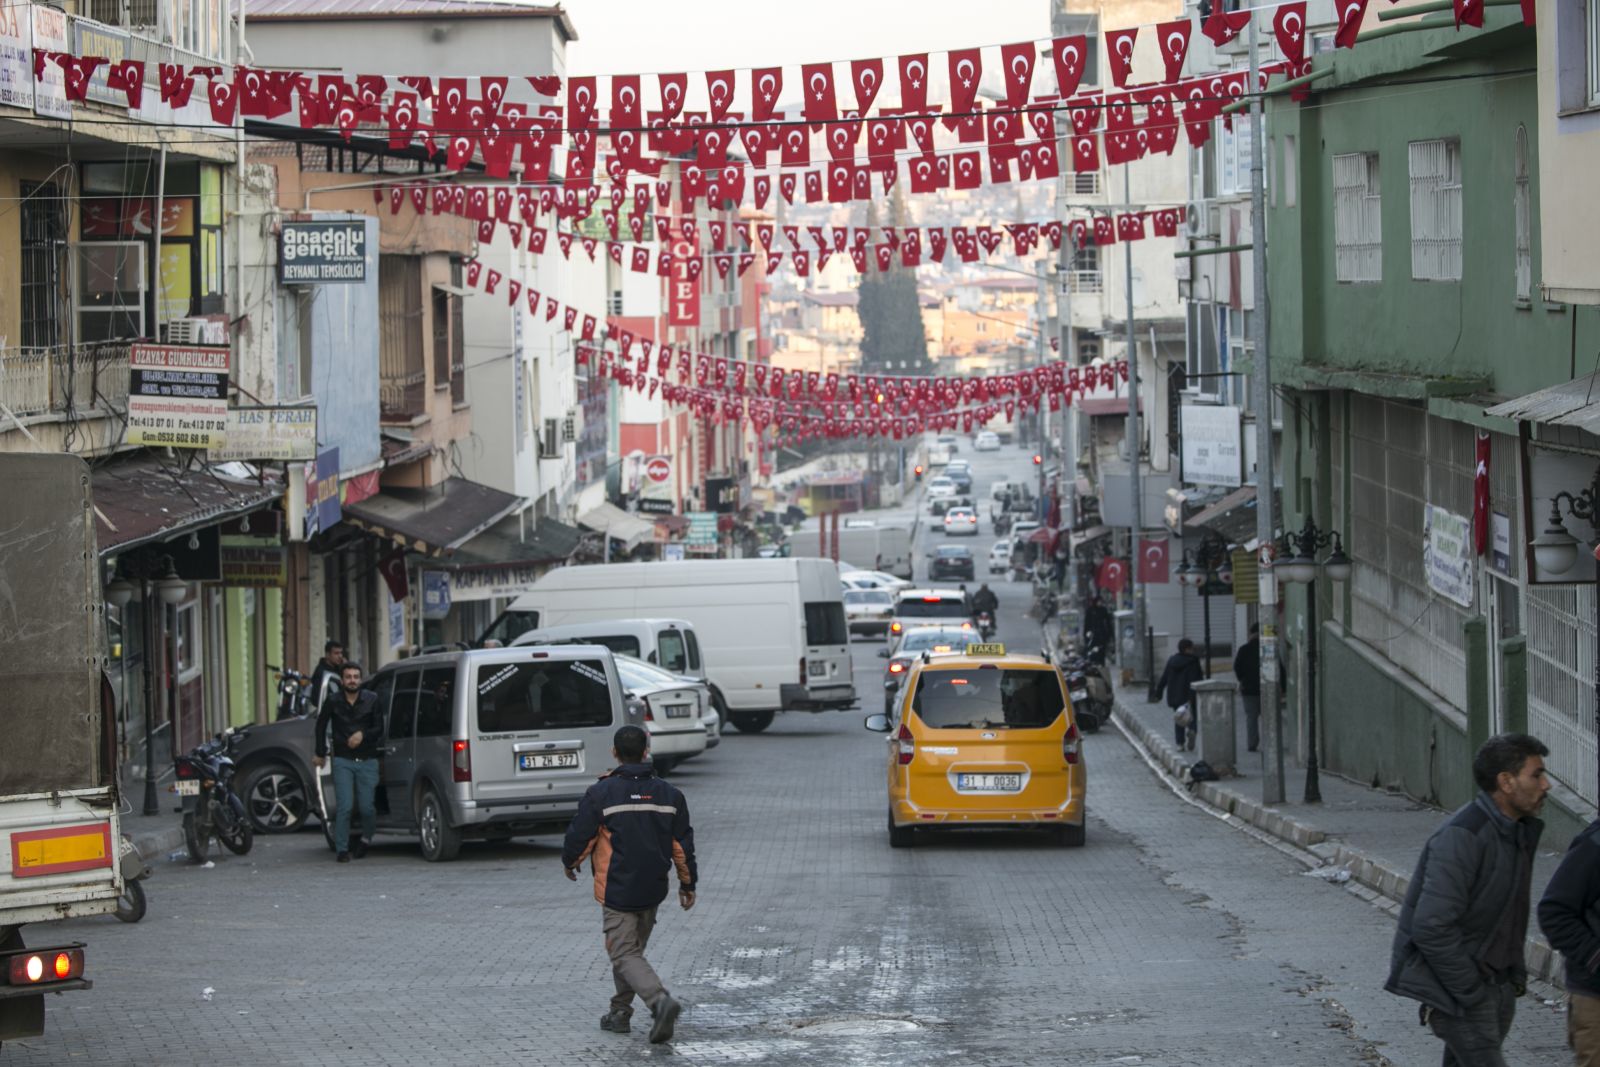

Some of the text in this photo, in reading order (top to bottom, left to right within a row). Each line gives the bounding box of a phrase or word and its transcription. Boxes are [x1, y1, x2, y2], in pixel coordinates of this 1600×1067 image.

[283, 227, 364, 244] anadolu
[283, 238, 358, 260] gençlik
[284, 264, 319, 279] REYHANLI
[168, 349, 226, 368] GÜMRÜKLEME
[239, 410, 312, 424] HAS FERAH
[156, 418, 165, 428] 07
[166, 418, 174, 428] 01
[206, 420, 215, 431] 07
[216, 421, 225, 431] 02
[176, 433, 189, 443] 602
[201, 434, 210, 444] 99
[527, 755, 574, 767] 31 ZH 977
[964, 775, 1016, 786] 31 T 0036
